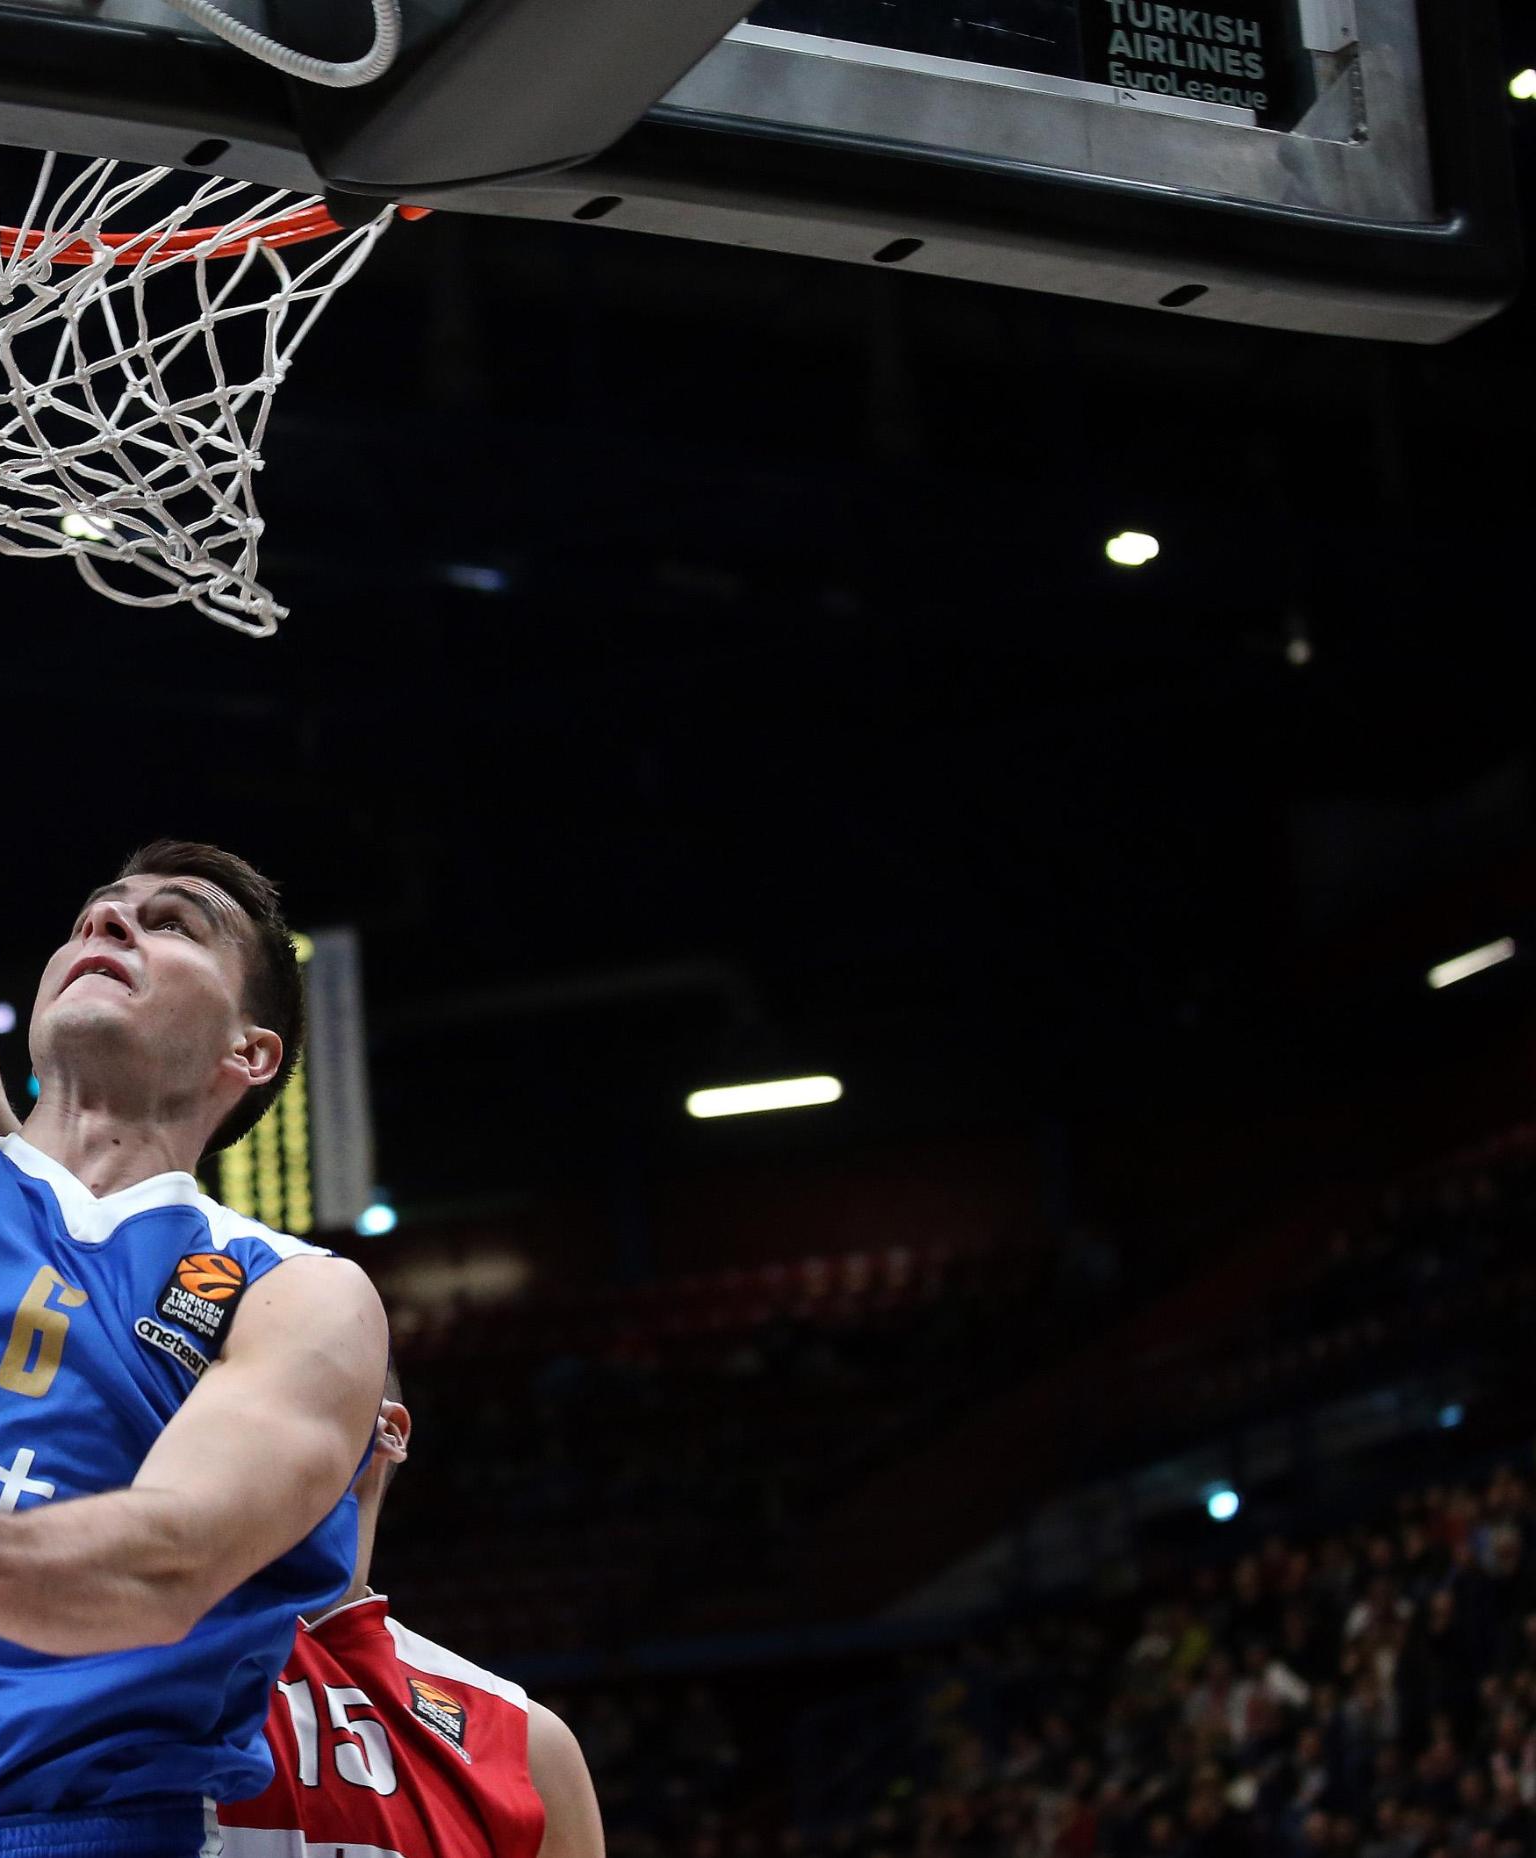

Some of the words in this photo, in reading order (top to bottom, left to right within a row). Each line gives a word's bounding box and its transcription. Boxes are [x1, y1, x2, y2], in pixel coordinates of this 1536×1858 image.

[1105, 0, 1263, 48] TURKISH
[1107, 29, 1265, 80] AIRLINES
[1108, 61, 1268, 110] EuroLeague
[165, 1296, 221, 1328] AIRLINES
[170, 1287, 224, 1319] TURKISH
[277, 1679, 398, 1796] 15
